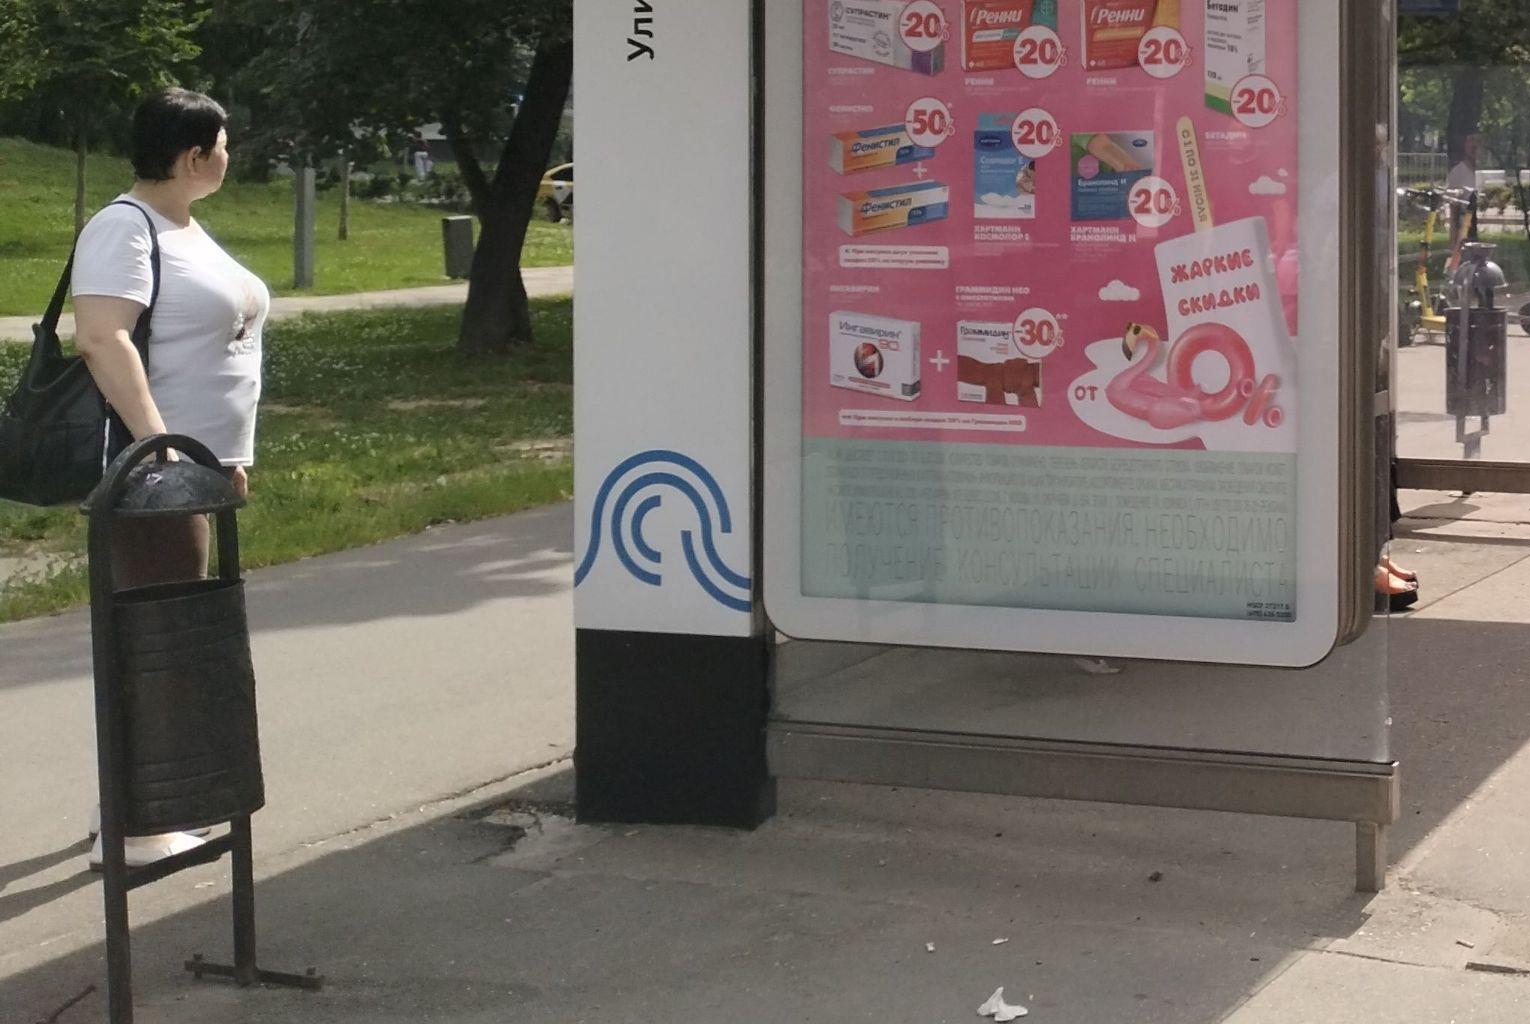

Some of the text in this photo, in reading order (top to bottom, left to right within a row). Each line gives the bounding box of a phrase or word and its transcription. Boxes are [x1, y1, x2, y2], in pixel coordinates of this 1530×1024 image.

[1170, 248, 1254, 284] ЖАРКИЕ
[1178, 282, 1261, 316] СКИДКИ
[1144, 512, 1289, 554] НЕОБХОДИМО
